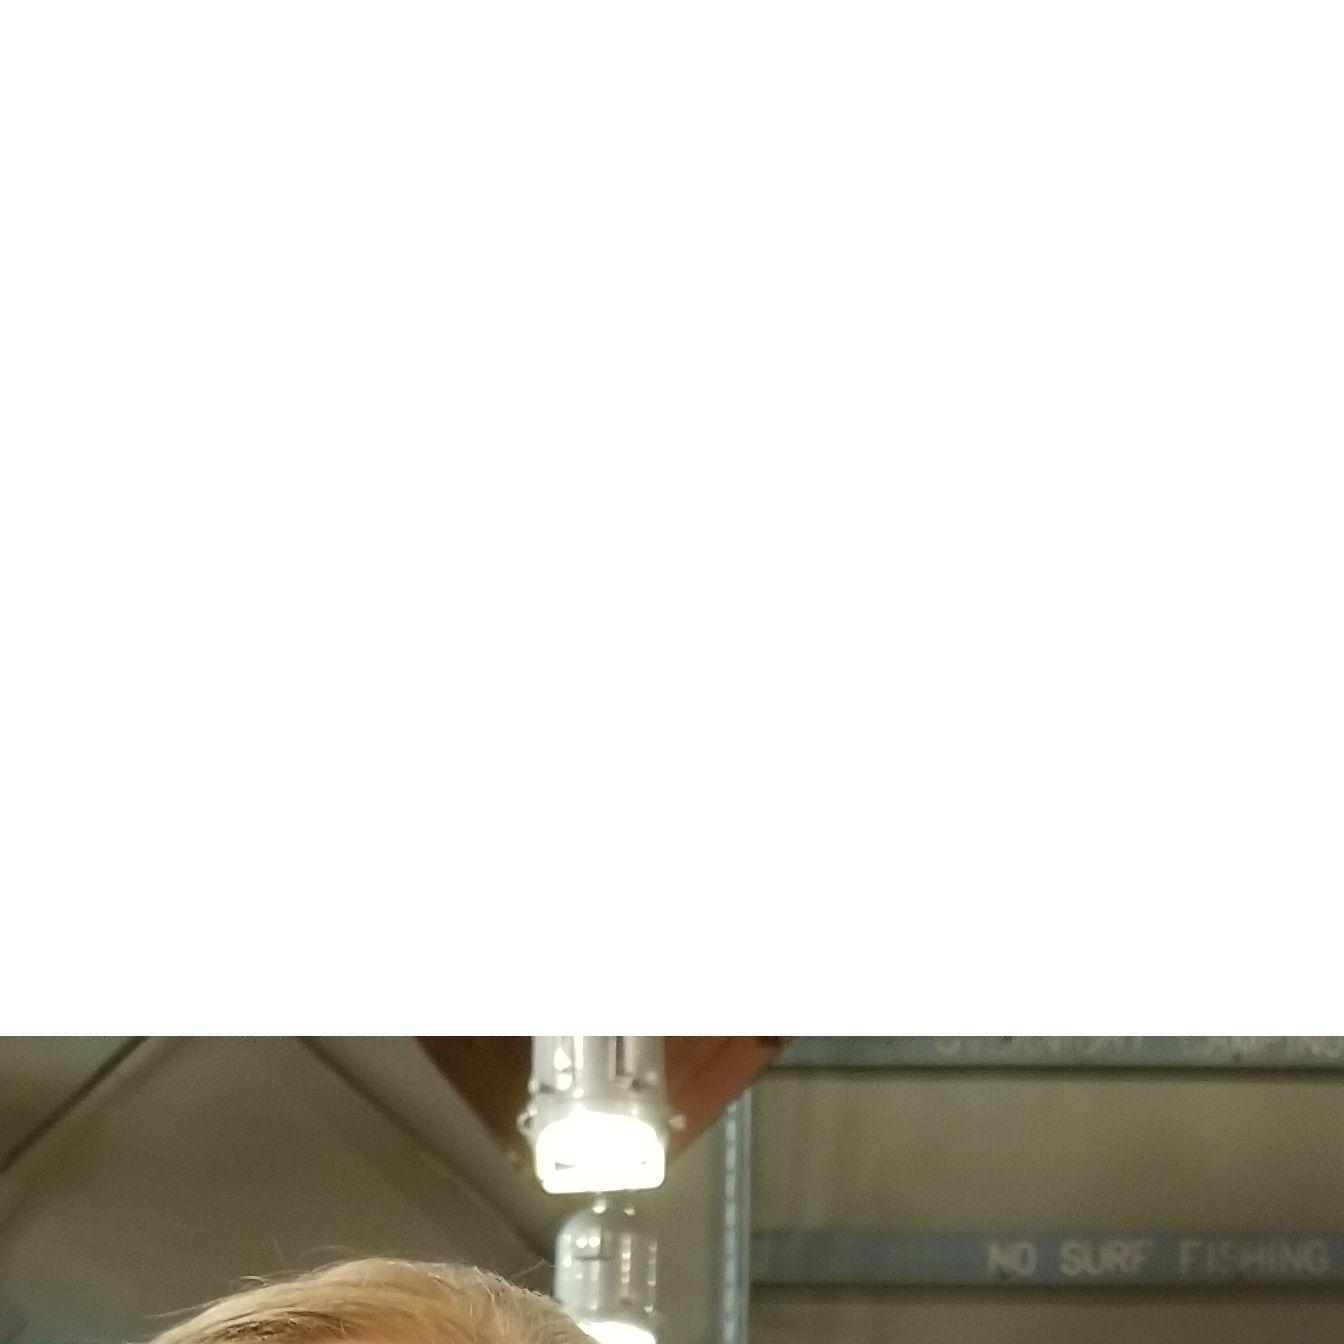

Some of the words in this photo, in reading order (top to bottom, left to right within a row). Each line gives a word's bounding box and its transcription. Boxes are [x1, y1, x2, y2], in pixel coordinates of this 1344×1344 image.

[987, 1240, 1038, 1277] NO
[1060, 1239, 1150, 1277] SURF
[1180, 1240, 1330, 1278] FISHING
